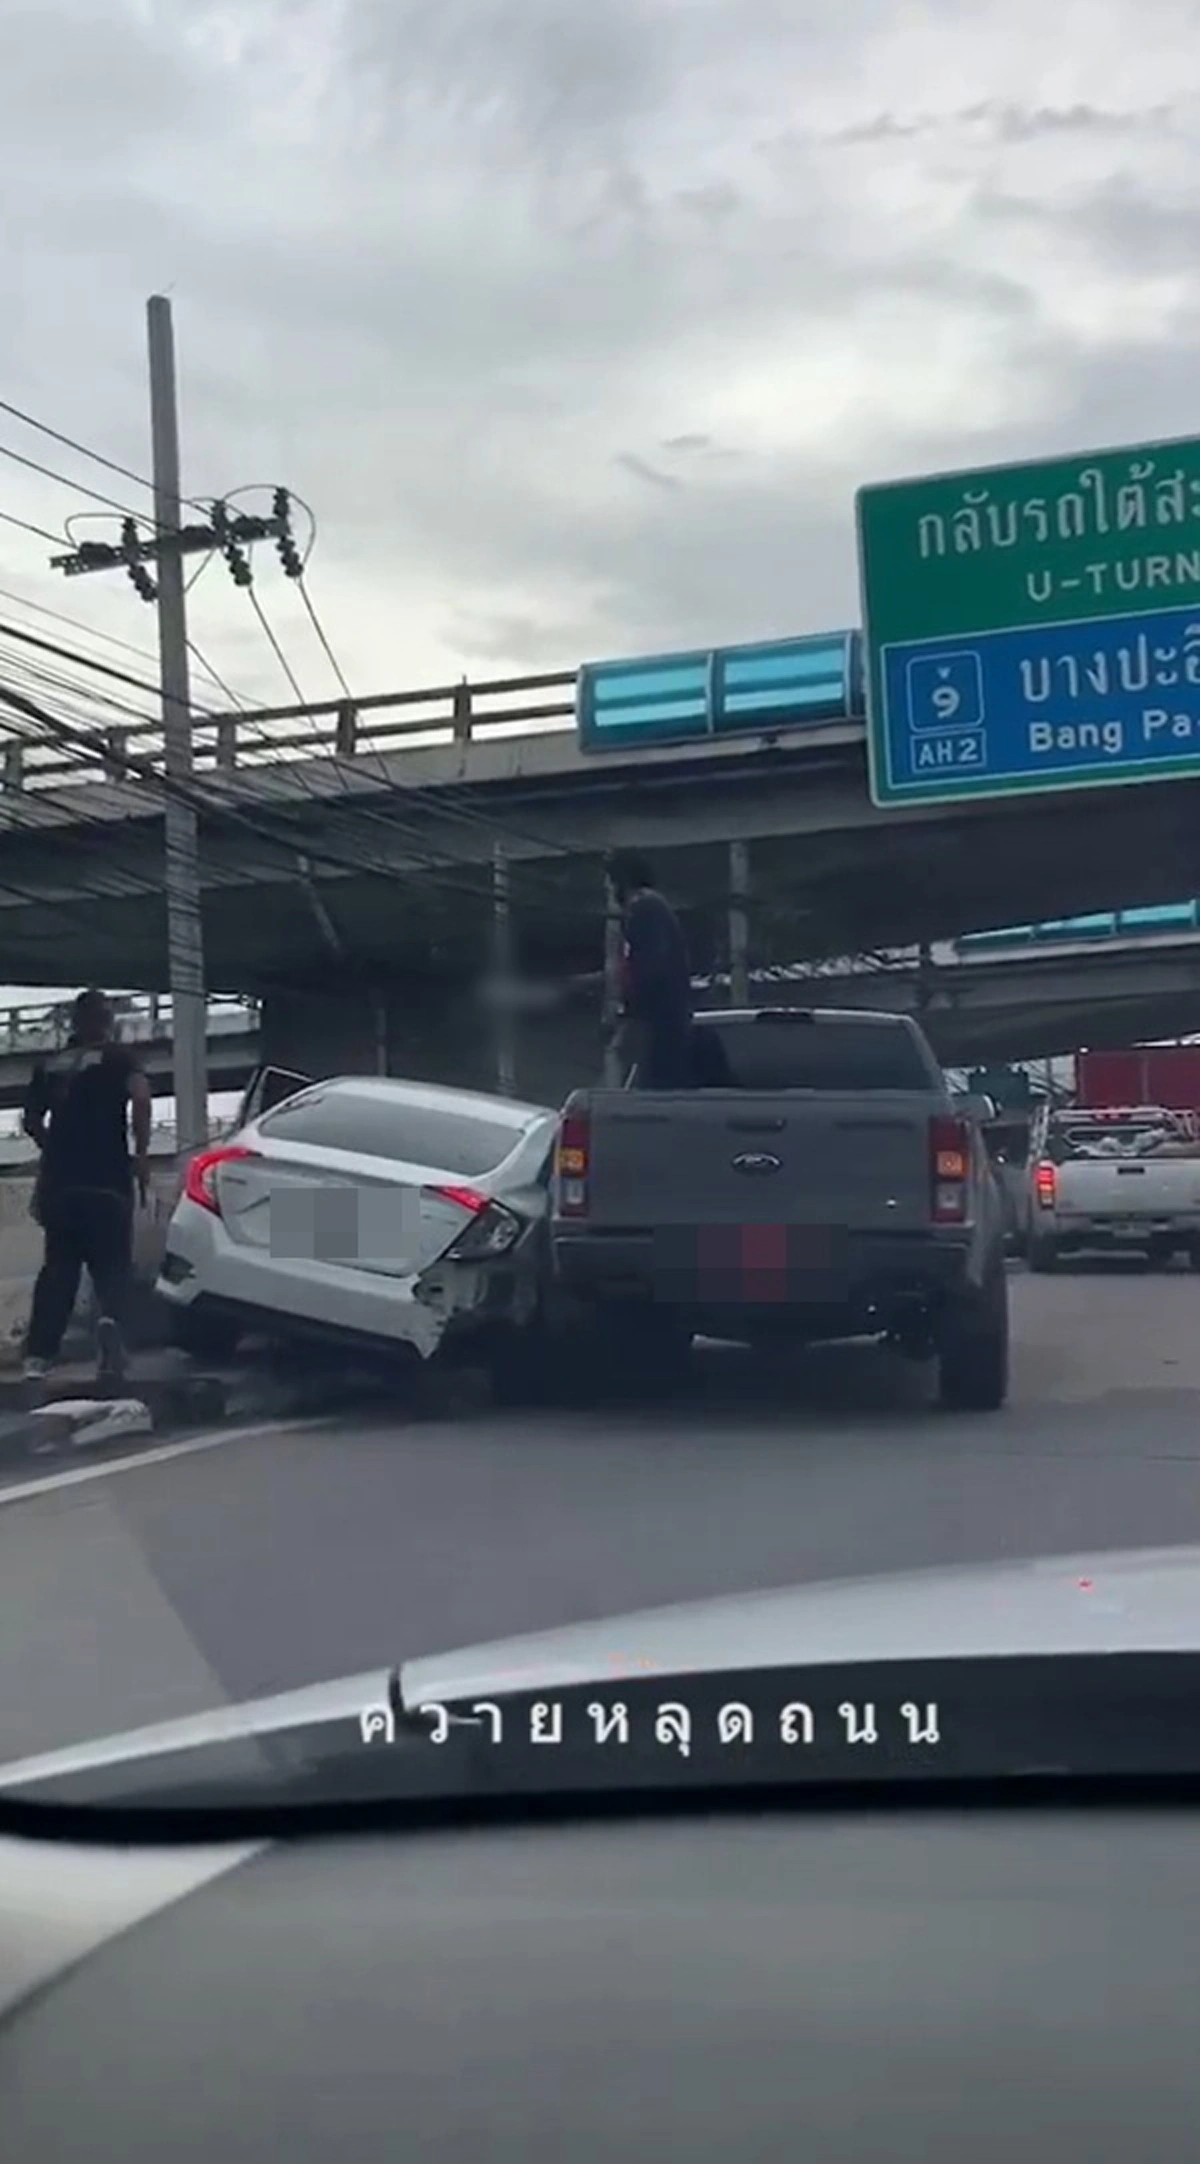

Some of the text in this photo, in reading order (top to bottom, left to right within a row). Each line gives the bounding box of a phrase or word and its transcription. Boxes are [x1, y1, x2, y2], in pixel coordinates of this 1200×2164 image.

[1026, 550, 1200, 601] U-TURN
[932, 686, 960, 719] 9
[1029, 708, 1200, 754] Bang Pa
[918, 738, 979, 766] AH2
